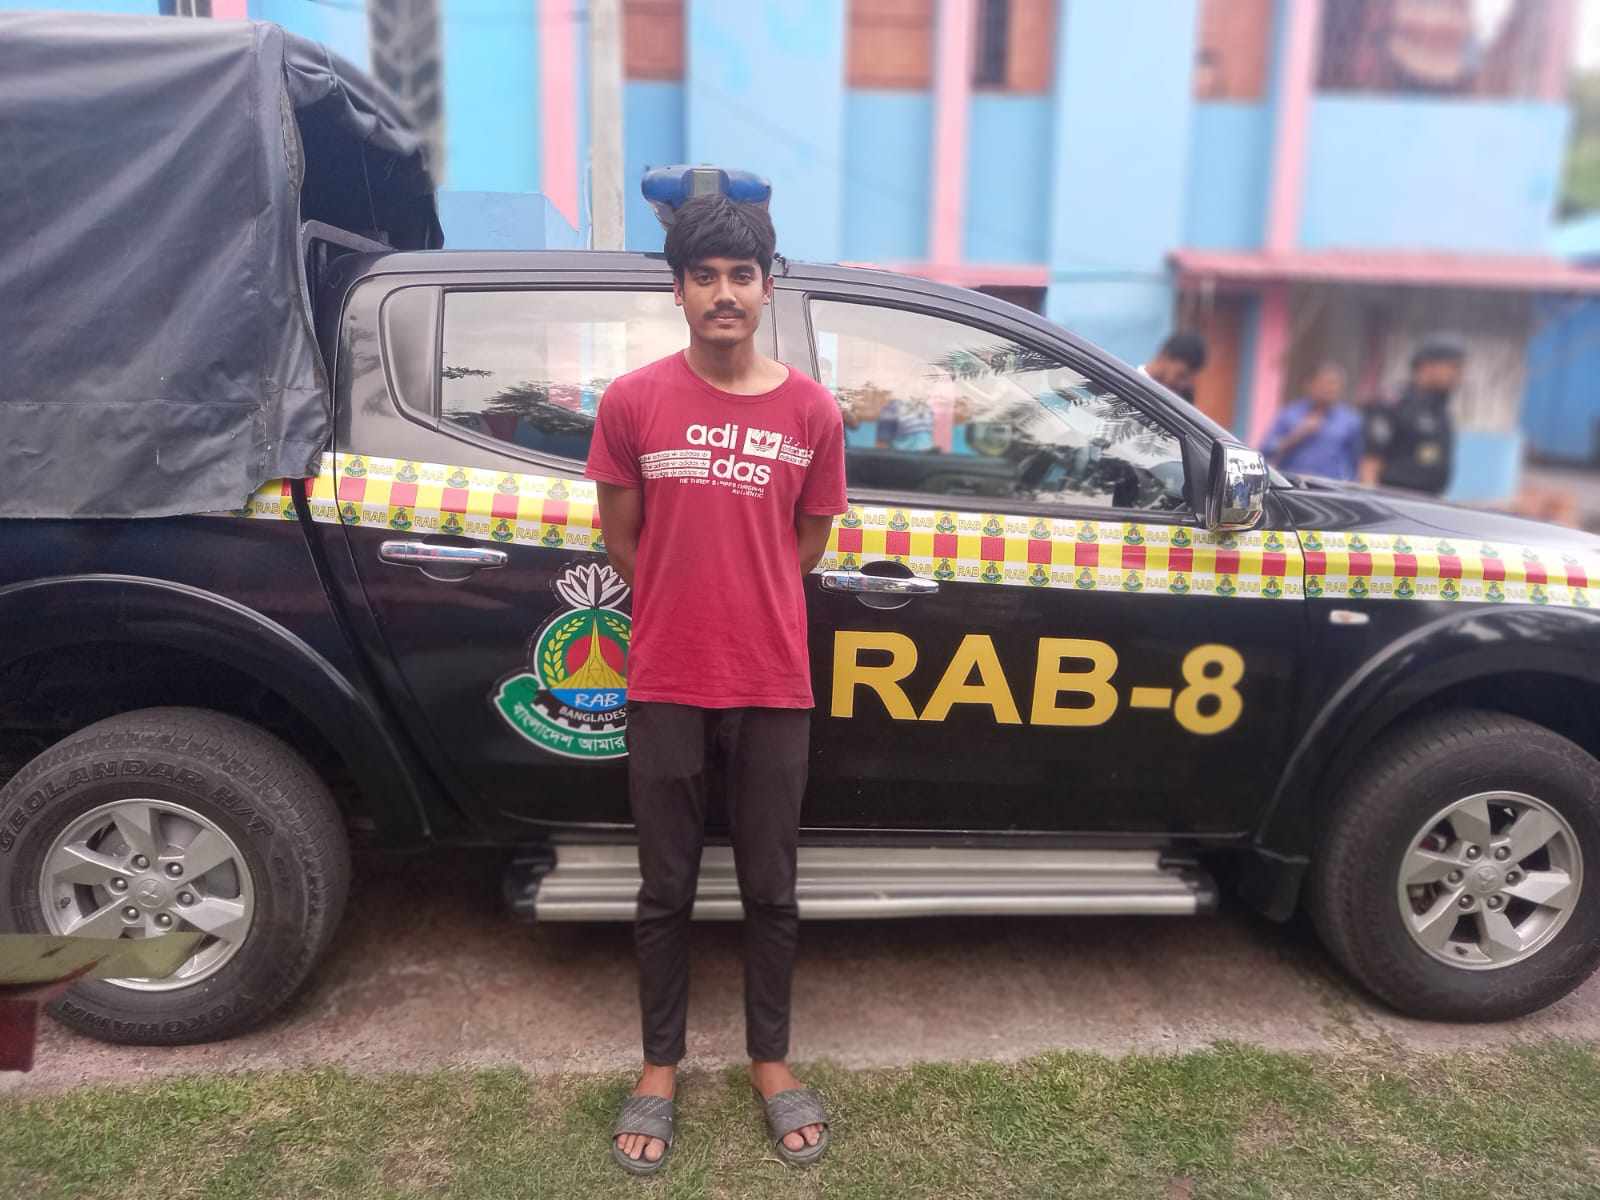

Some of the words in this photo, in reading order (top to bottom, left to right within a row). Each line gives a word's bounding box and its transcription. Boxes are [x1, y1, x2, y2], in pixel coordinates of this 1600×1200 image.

[686, 423, 739, 450] adi
[712, 454, 771, 485] das
[255, 502, 281, 515] RAB
[362, 510, 387, 524] RAB
[415, 515, 438, 529] RAB
[957, 565, 980, 578] RAB
[830, 630, 1246, 736] RAB-8
[575, 692, 620, 707] RAB
[559, 707, 627, 723] BANGLADES
